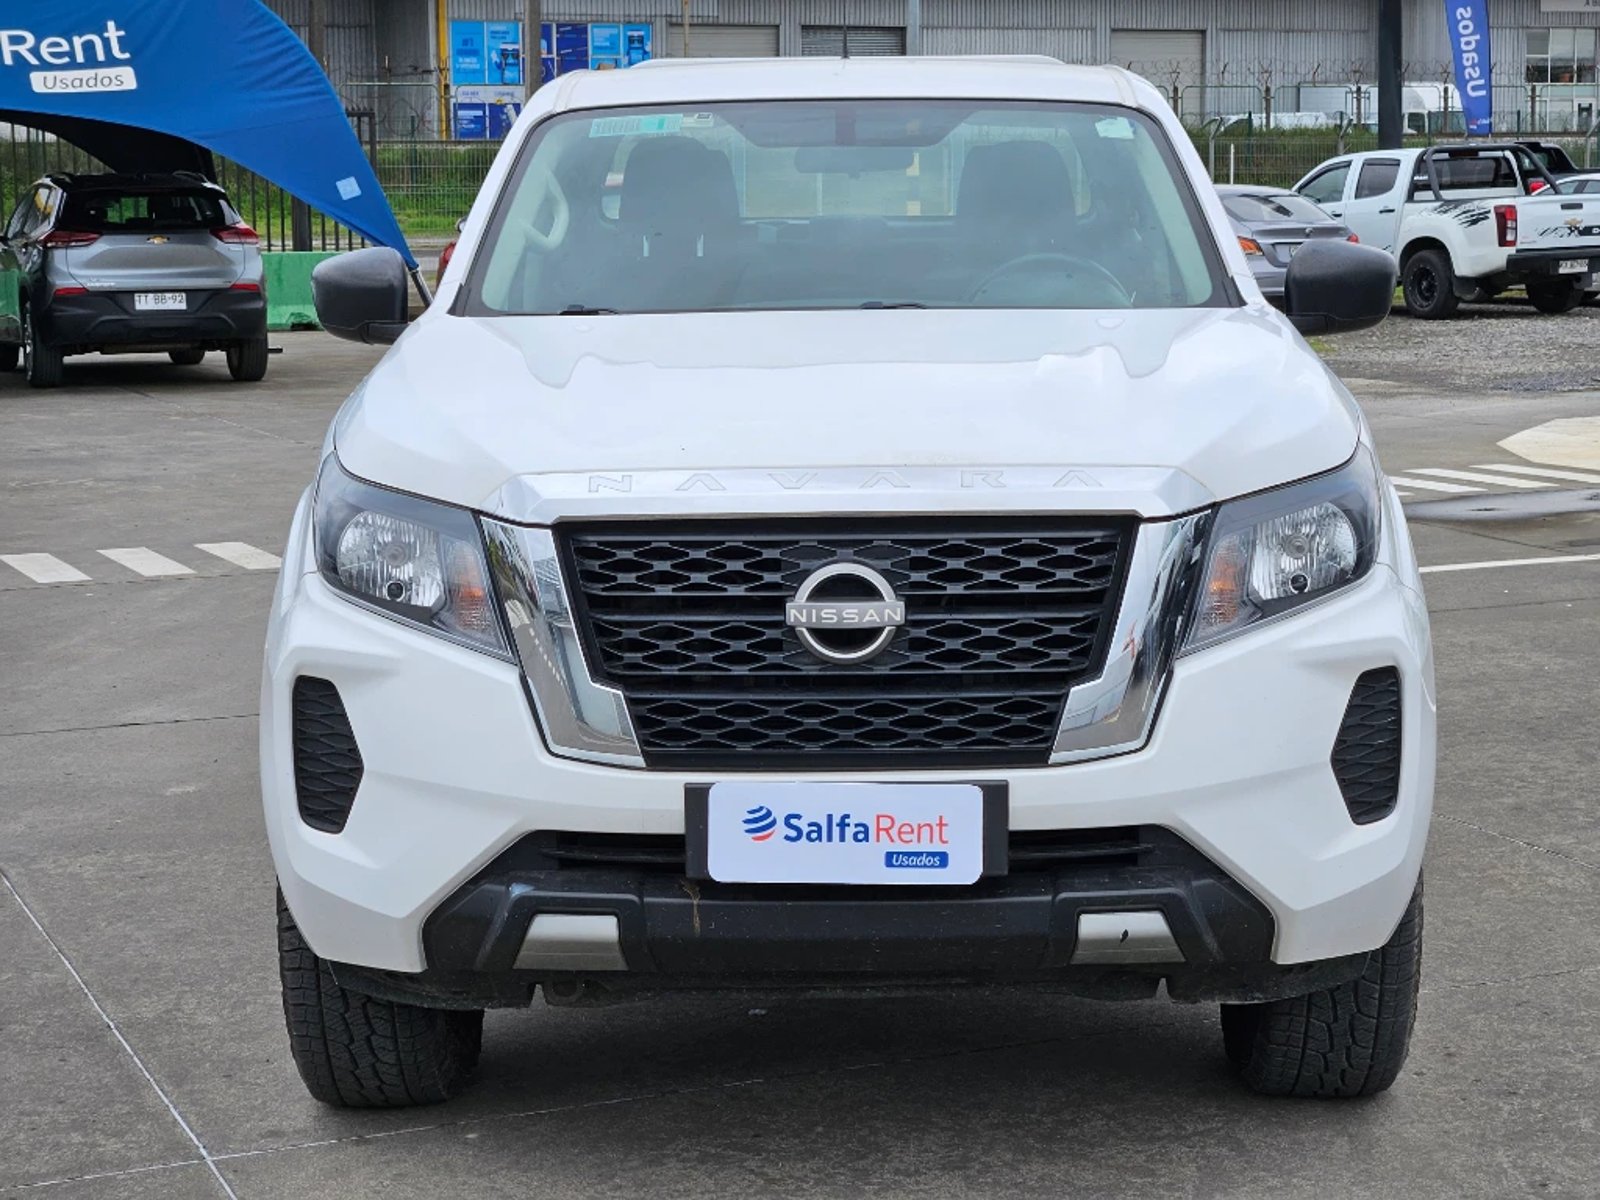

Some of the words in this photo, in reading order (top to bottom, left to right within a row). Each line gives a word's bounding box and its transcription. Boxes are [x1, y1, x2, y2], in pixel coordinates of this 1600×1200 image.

[0, 20, 131, 65] Rent
[43, 72, 124, 90] Usados
[588, 469, 1103, 493] NAVARA
[790, 608, 901, 623] NISSAN
[891, 853, 940, 867] Usados
